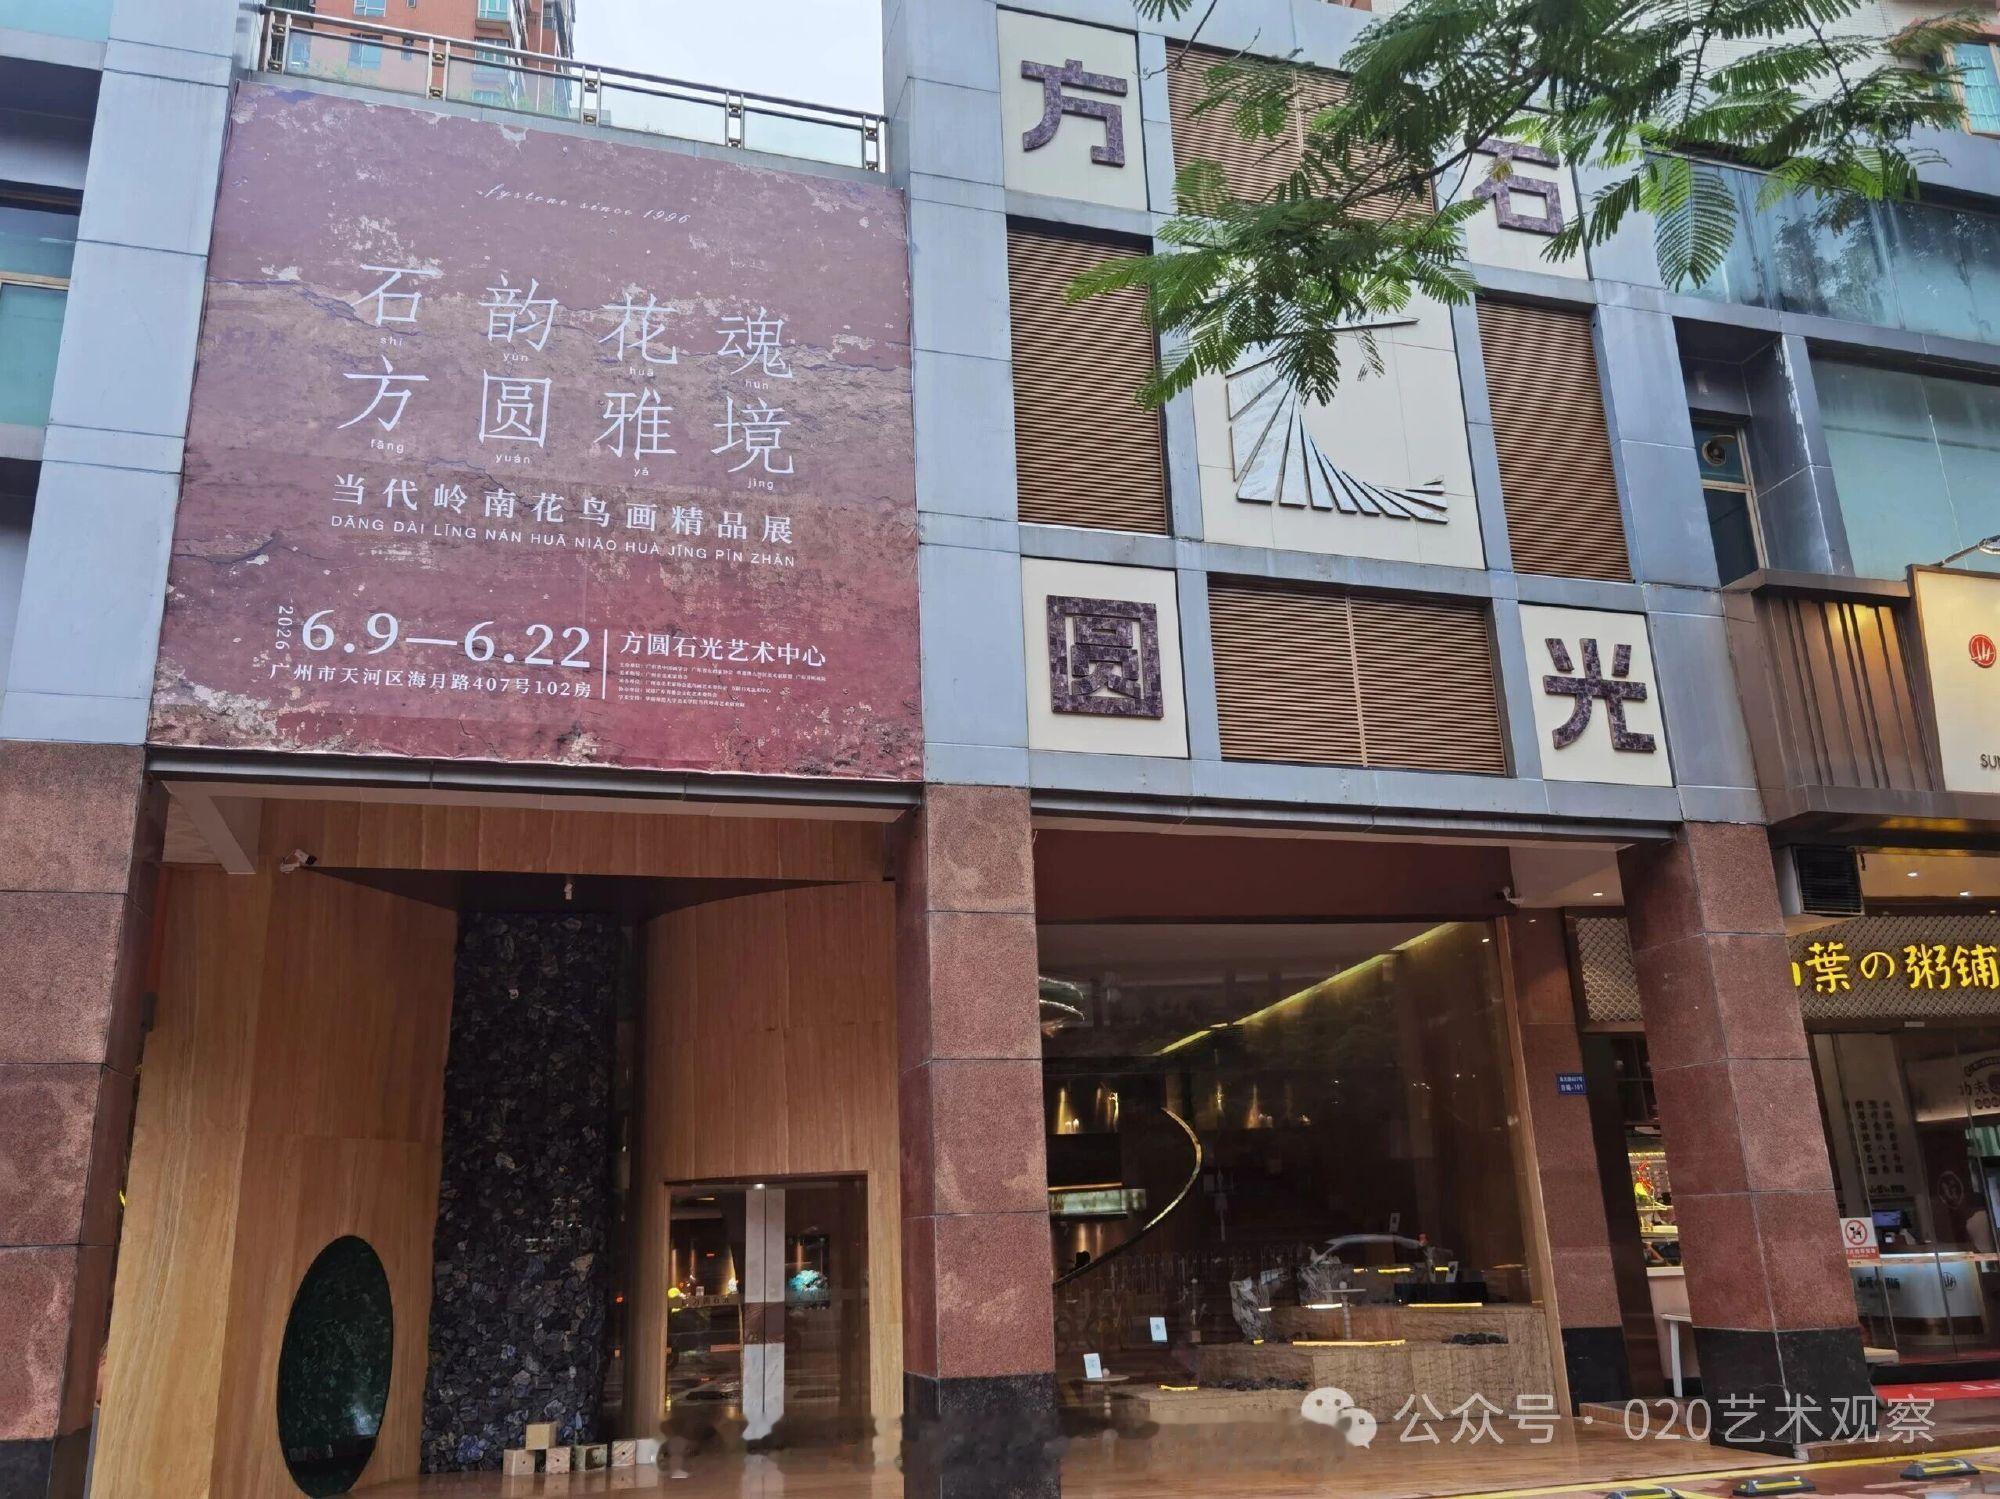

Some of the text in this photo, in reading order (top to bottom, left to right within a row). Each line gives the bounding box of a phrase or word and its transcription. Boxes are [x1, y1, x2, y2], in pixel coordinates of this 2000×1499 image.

[1021, 59, 1127, 168] 方
[580, 202, 633, 216] since
[643, 209, 692, 224] 1996
[1472, 138, 1564, 236] 石
[350, 263, 794, 379] 石韵花魂
[337, 355, 794, 474] 方圆雅境
[333, 473, 794, 544] 当代岭南花鸟画精品展
[275, 605, 294, 651] 2026
[619, 631, 826, 667] 方圆石光艺术中心
[269, 662, 592, 698] 广州市天河区海月路407号102房
[1542, 637, 1657, 754] 光
[1792, 942, 2000, 994] 葉の粥铺
